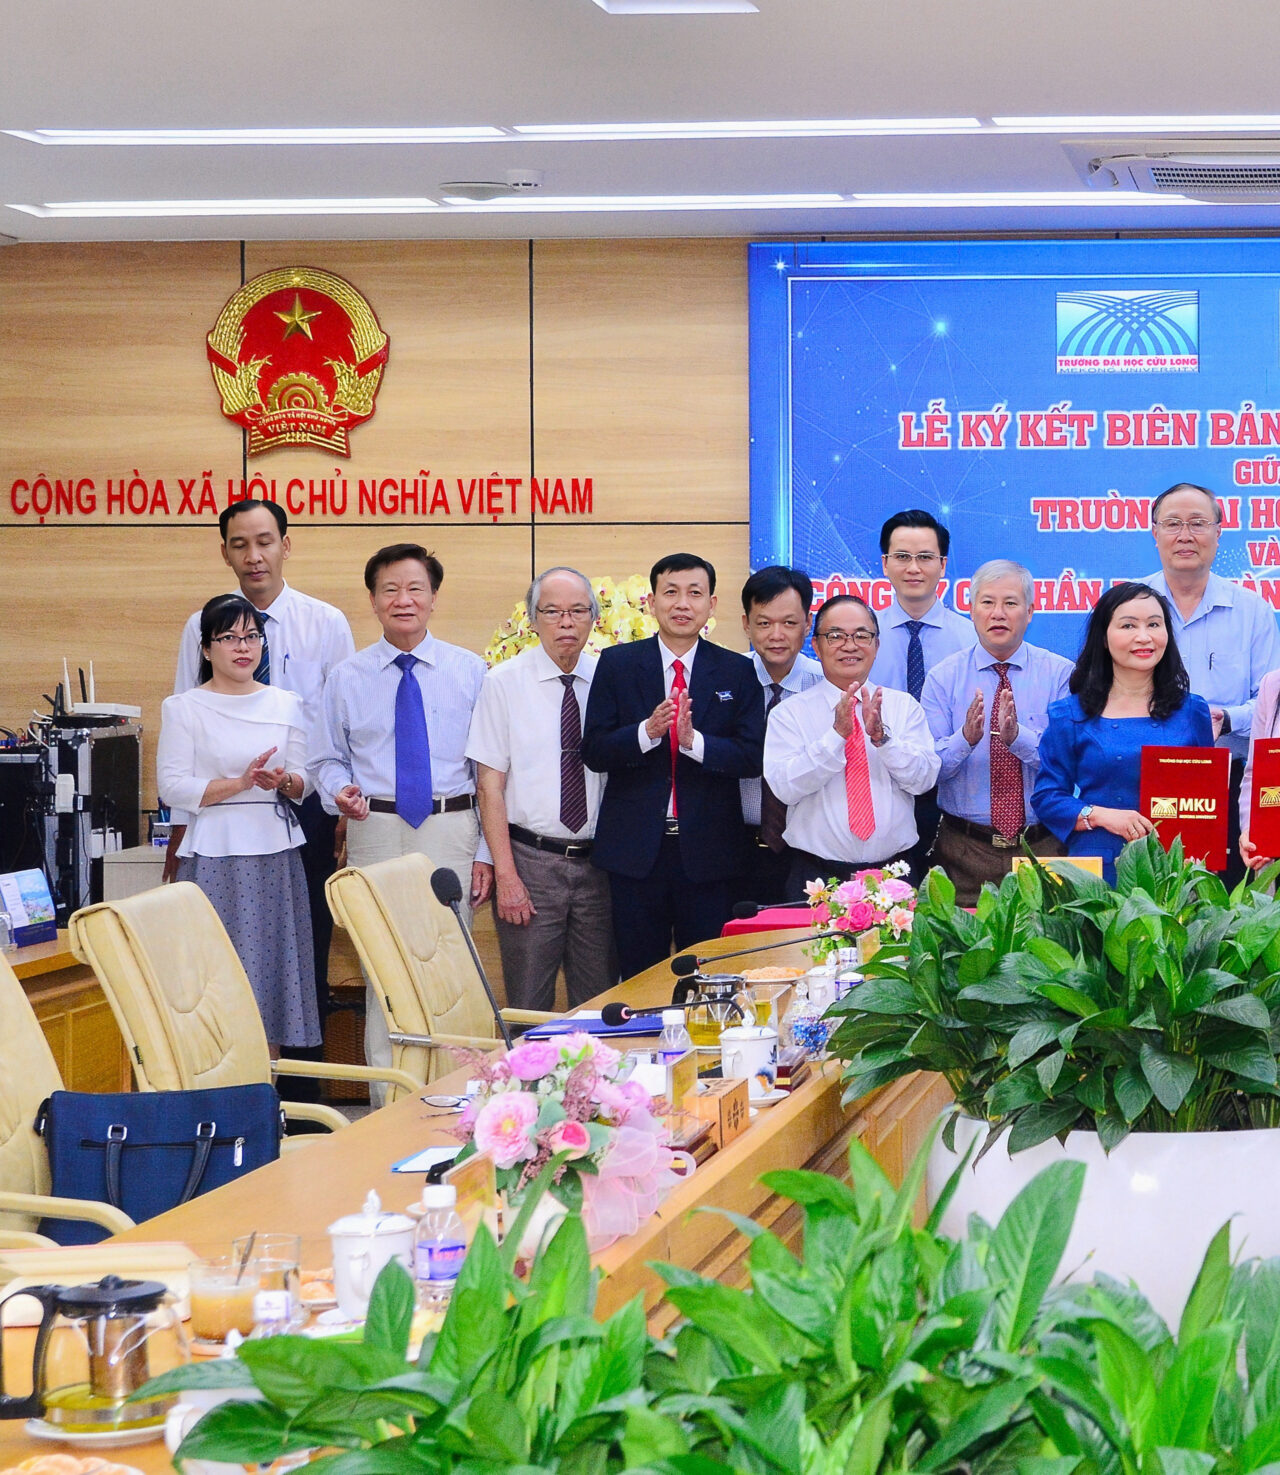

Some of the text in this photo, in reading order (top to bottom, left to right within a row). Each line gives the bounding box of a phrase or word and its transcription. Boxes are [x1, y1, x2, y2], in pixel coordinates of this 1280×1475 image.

[1170, 358, 1198, 366] LONG
[901, 400, 949, 447] LỄ
[961, 406, 1009, 447] KÝ
[1019, 402, 1094, 447] KẾT
[1106, 406, 1197, 446] BIÊN
[10, 472, 97, 524] CỘNG
[107, 469, 170, 515] HÒA
[177, 470, 218, 515] XÃ
[286, 468, 347, 515] CHỦ
[358, 469, 451, 515] NGHĨA
[457, 471, 523, 522] VIỆT
[531, 477, 593, 515] NAM
[1033, 492, 1154, 530] TRƯỜN
[1033, 570, 1102, 611] HẦN
[1179, 798, 1216, 812] MKU
